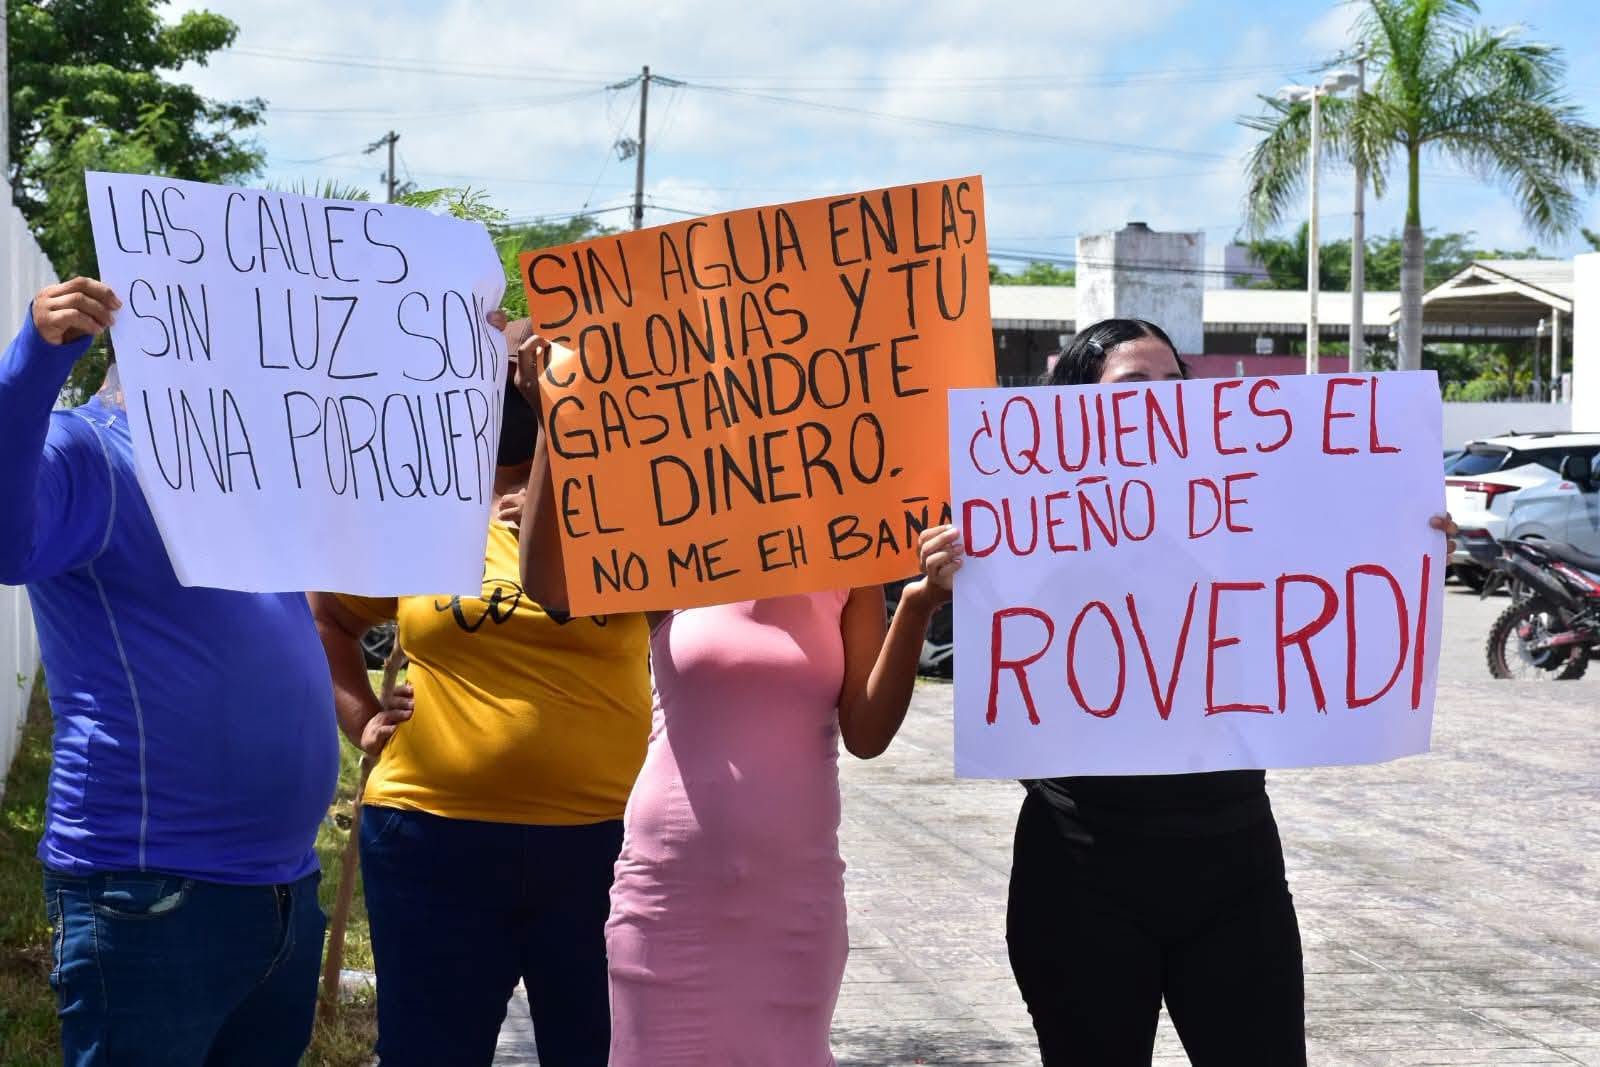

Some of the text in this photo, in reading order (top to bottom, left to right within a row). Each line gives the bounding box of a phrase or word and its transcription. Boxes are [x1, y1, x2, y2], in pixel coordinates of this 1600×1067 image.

[109, 186, 408, 284] LAS CALLES
[529, 181, 976, 329] SIN AGUA EN LAS
[130, 279, 499, 382] SIN LUZ SON
[543, 255, 968, 388] COLONIAS Y TU
[143, 386, 261, 494] UNA
[549, 335, 928, 459] GASTANDOTE
[969, 376, 1401, 475] ¿QUIEN ES EL
[561, 412, 904, 539] EL DINERO.
[962, 472, 1258, 558] DUEÑO DE
[592, 549, 649, 594] NO
[668, 539, 740, 588] ME
[759, 525, 806, 571] EH
[985, 553, 1431, 726] ROVERDI
